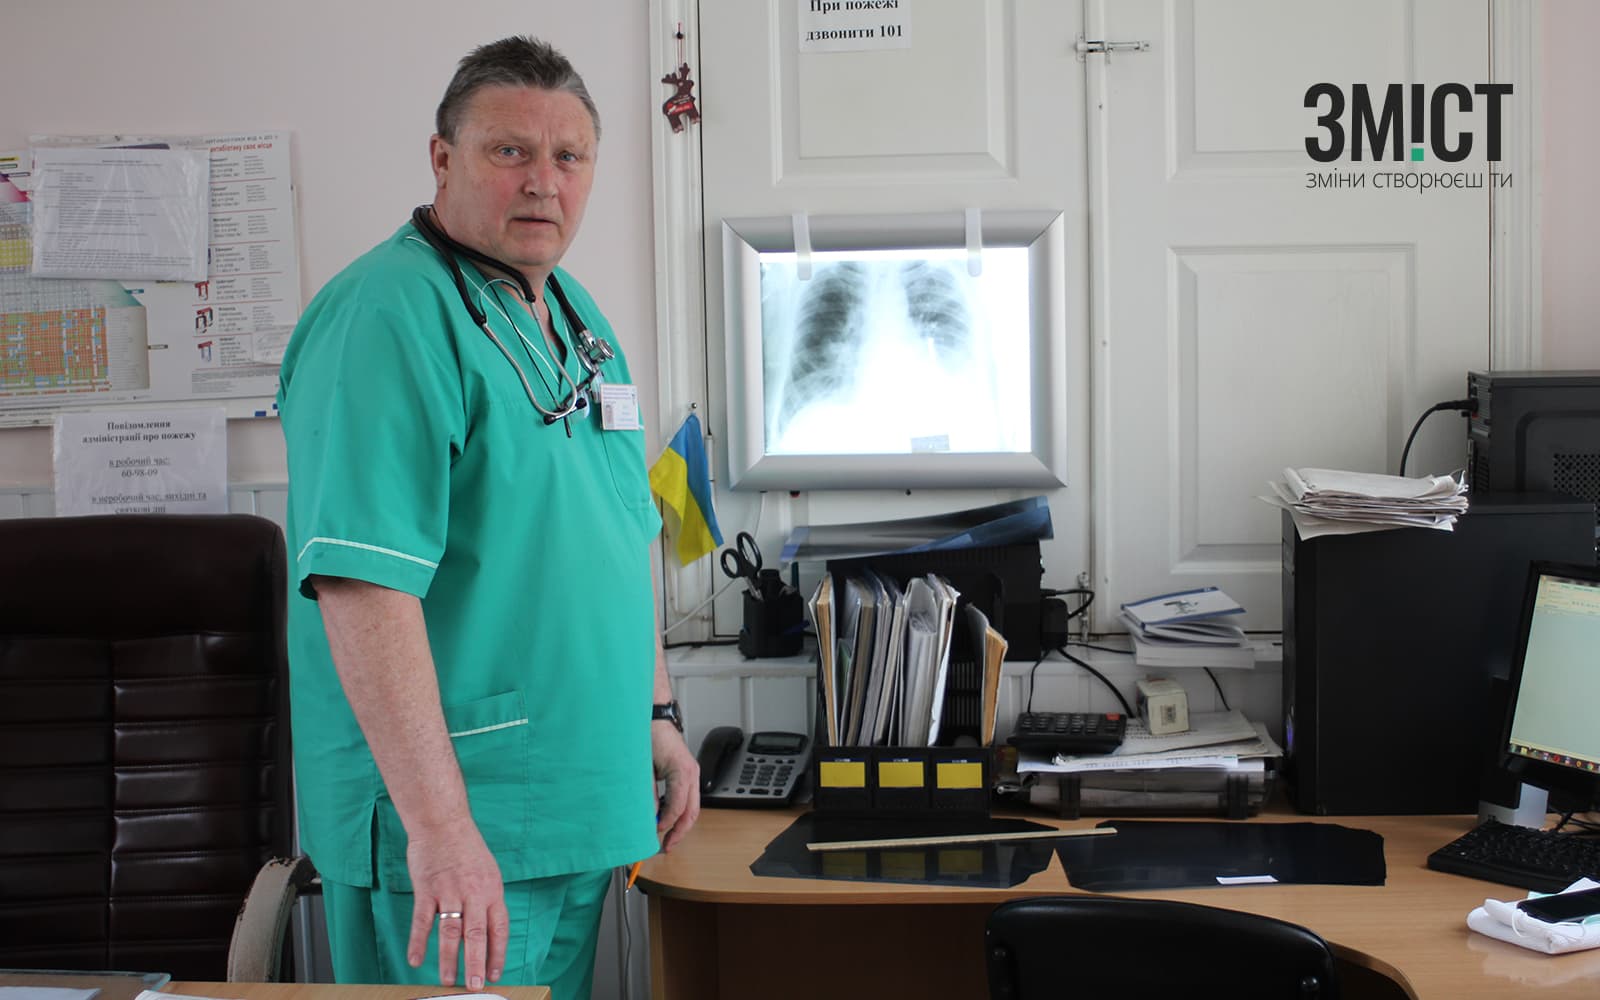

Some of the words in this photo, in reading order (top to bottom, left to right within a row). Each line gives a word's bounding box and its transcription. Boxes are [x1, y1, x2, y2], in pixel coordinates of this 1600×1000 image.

[810, 0, 840, 14] При
[845, 0, 899, 10] пожежі
[805, 29, 874, 41] дзвонити
[880, 25, 902, 37] 101
[107, 421, 171, 430] Повідомлення
[143, 433, 160, 443] про
[161, 431, 195, 441] пожежу
